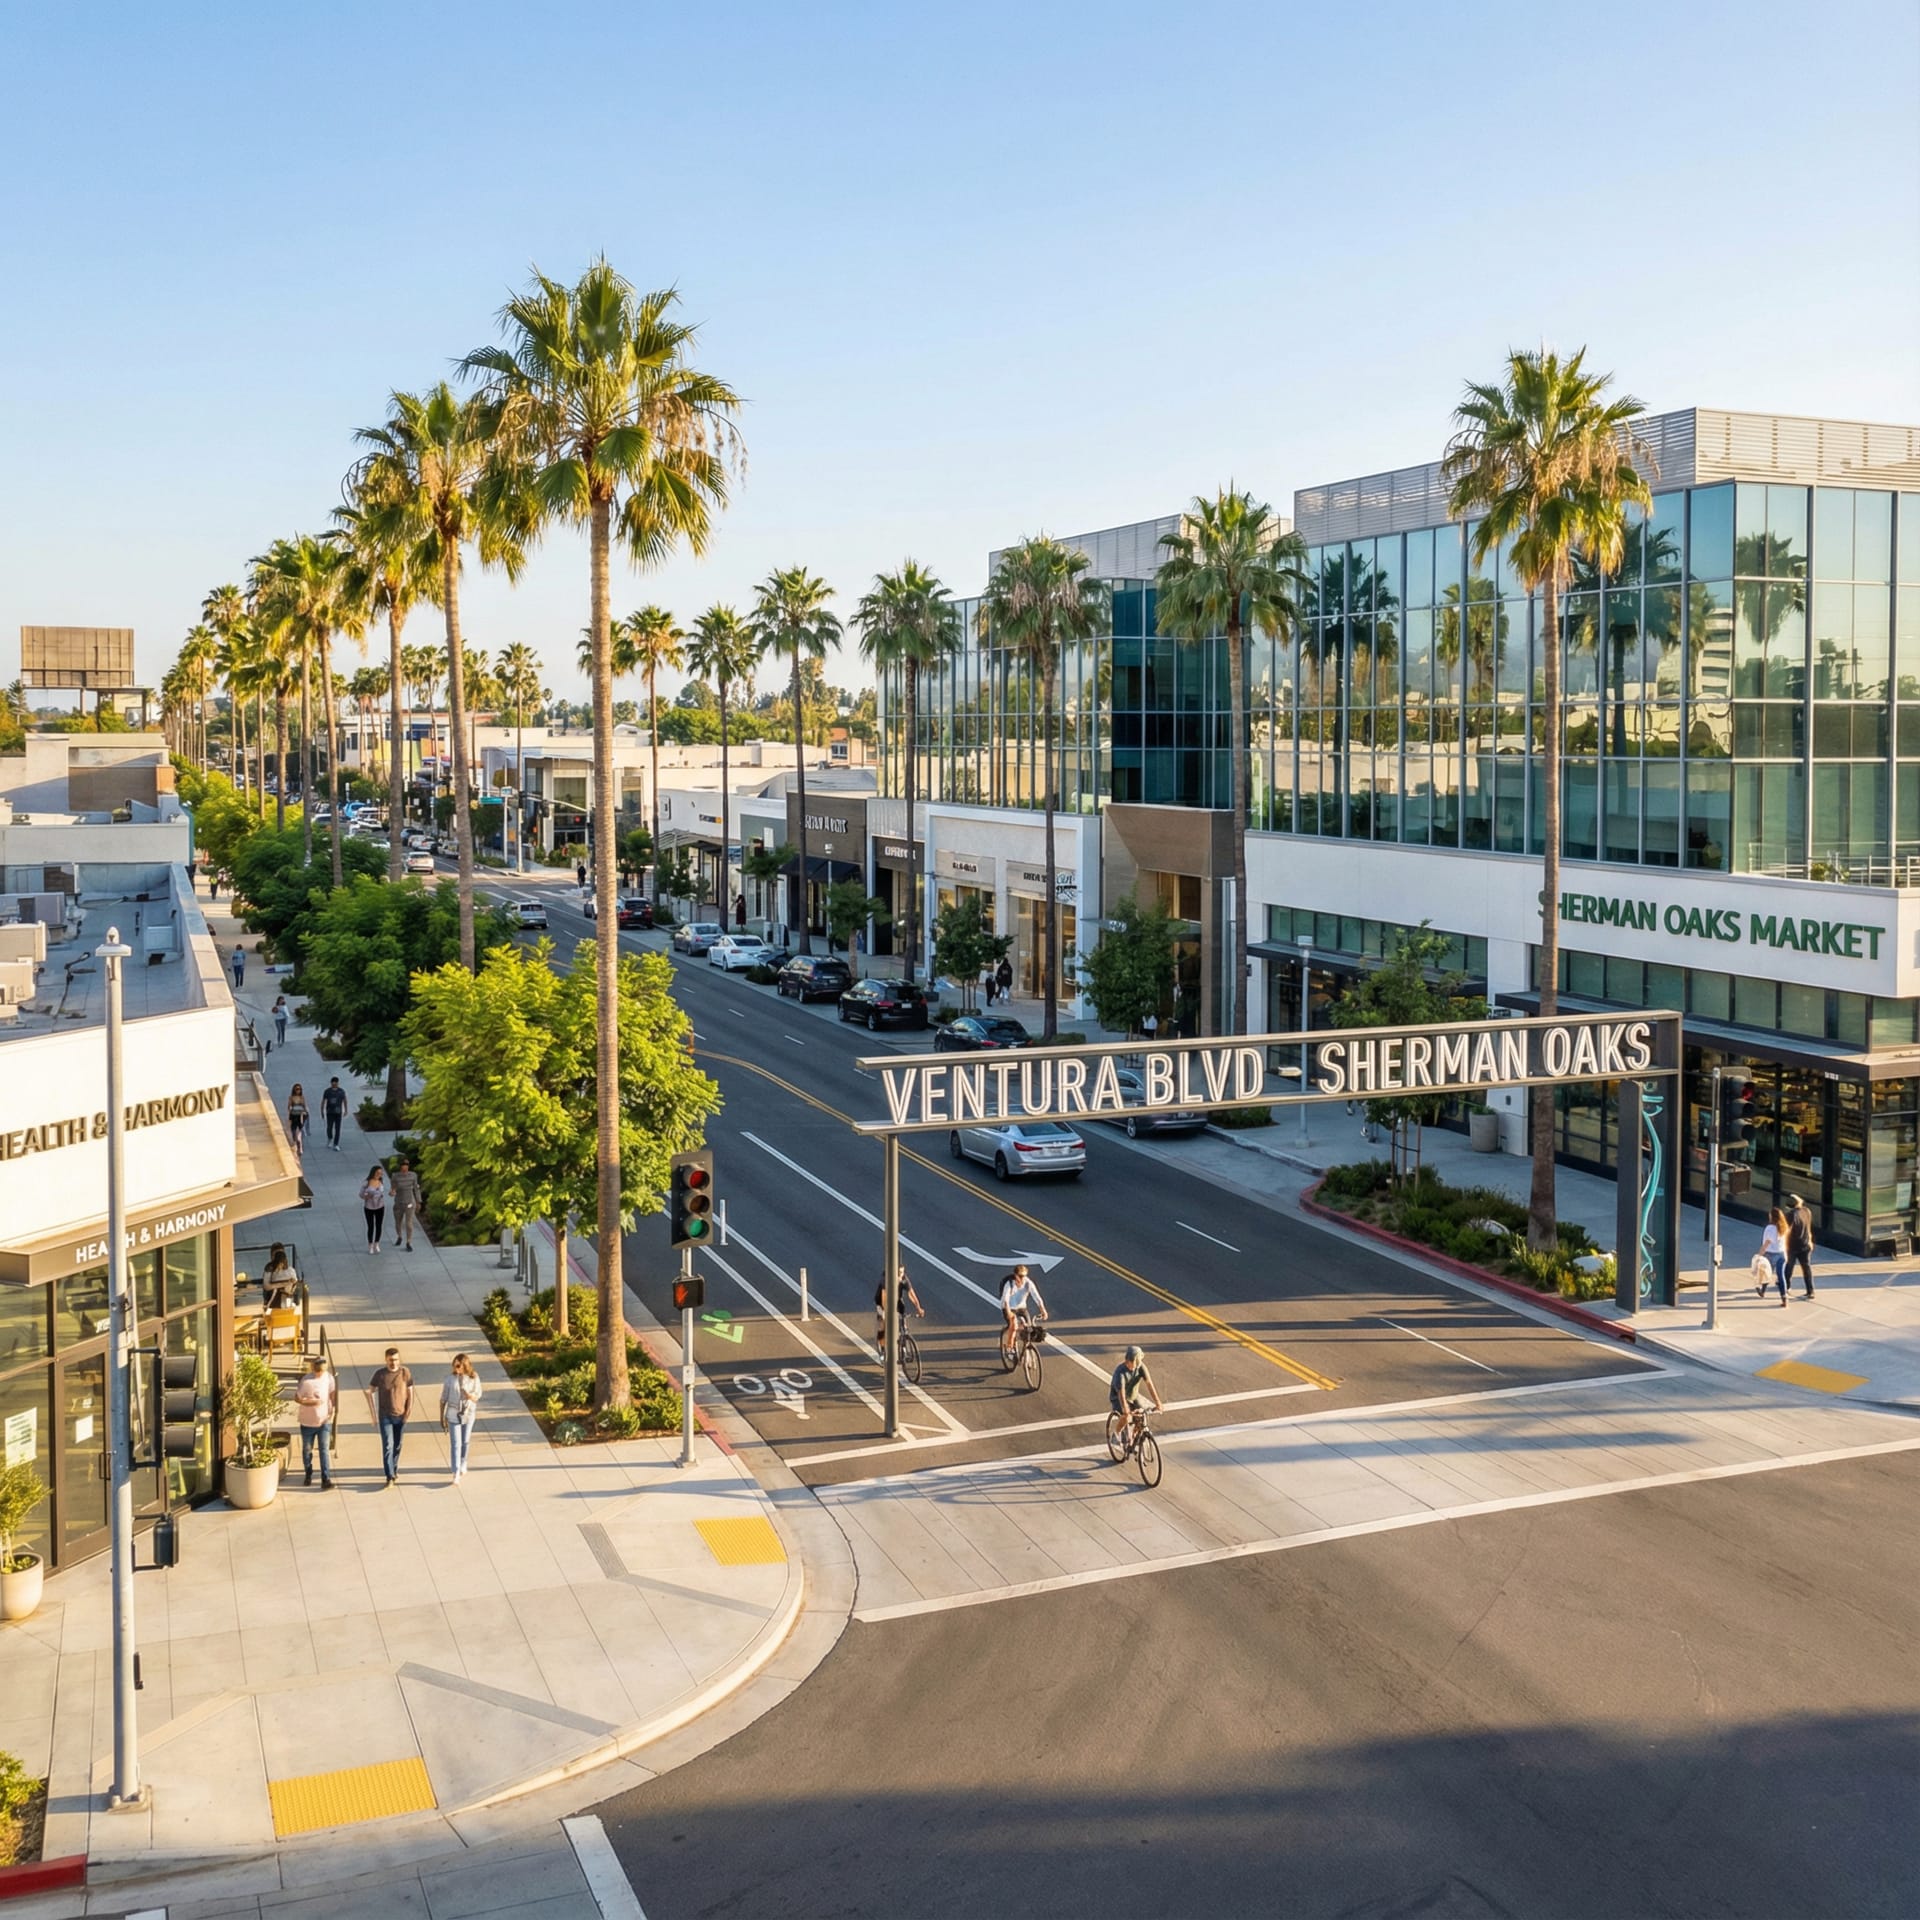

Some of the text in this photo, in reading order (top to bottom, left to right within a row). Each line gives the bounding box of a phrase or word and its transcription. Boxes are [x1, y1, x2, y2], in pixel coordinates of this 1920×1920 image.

[1664, 904, 1741, 942] OAKS
[1750, 914, 1885, 960] MARKET
[882, 1022, 1650, 1125] VENTURA BLVD SHERMAN OAKS
[92, 1112, 108, 1139] &
[76, 1204, 226, 1264] HEAH & HARMONY
